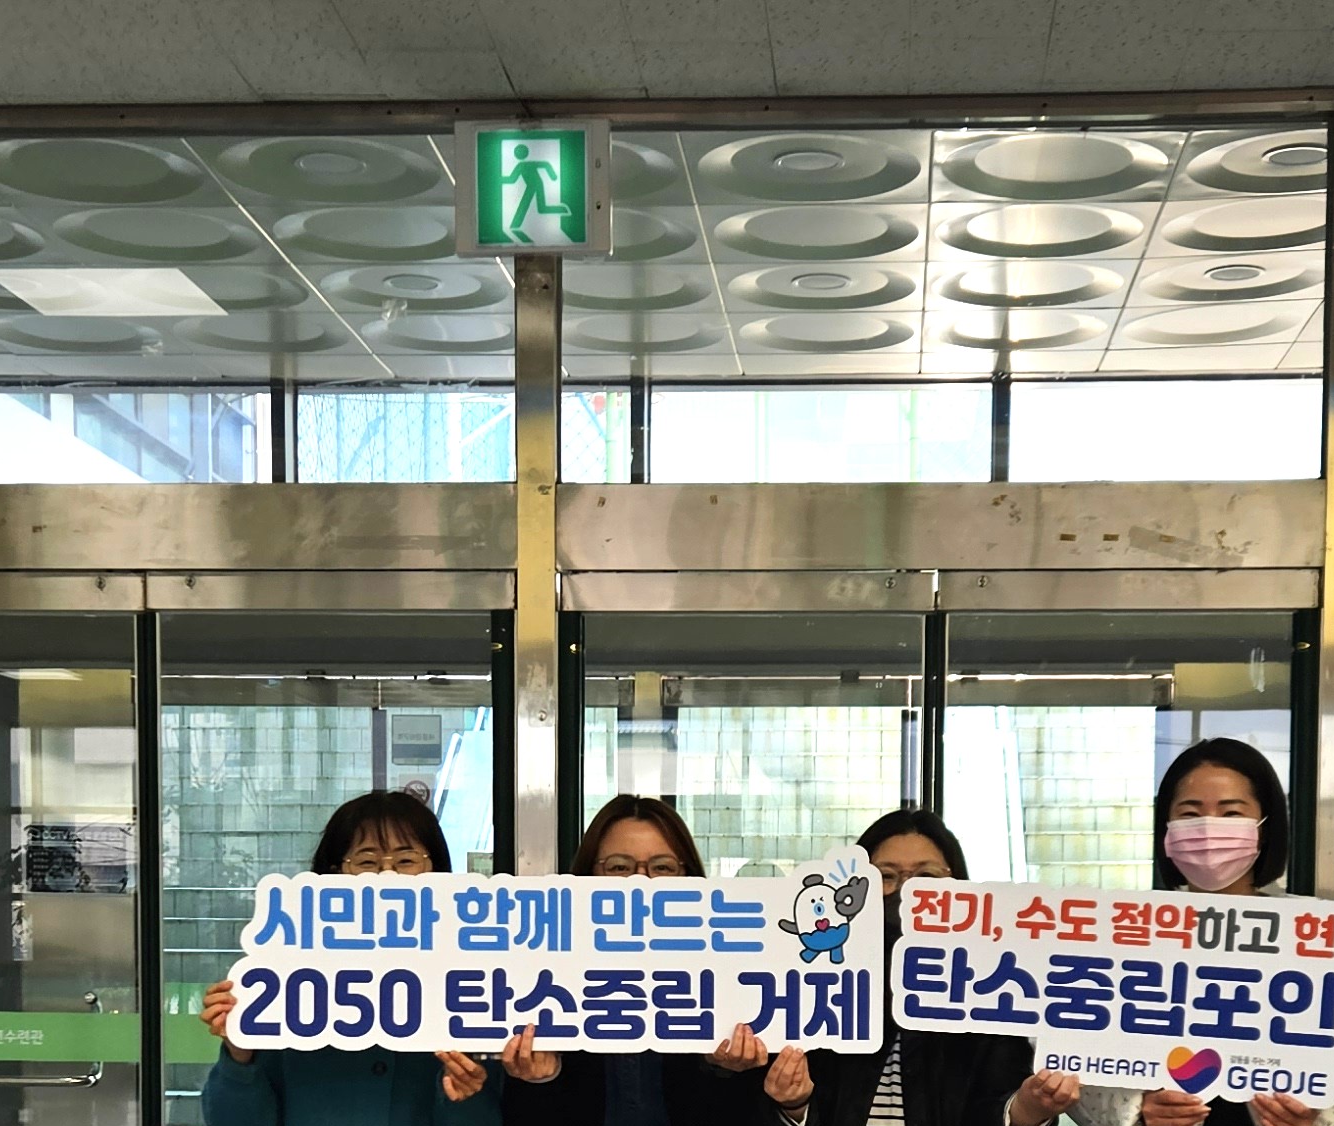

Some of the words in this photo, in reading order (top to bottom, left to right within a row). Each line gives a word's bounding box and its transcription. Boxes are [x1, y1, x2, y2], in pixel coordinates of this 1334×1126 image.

[254, 885, 440, 951] 시민과
[454, 885, 574, 952] 함께
[591, 886, 765, 953] 만드는
[910, 888, 1003, 942] 전기,
[1015, 895, 1099, 944] 수도
[1111, 902, 1281, 957] 절약하고
[239, 966, 422, 1039] 2050
[445, 967, 715, 1041] 탄소중립
[737, 967, 871, 1042] 거제
[1045, 1053, 1082, 1073] BIG
[1085, 1056, 1161, 1079] HEART
[1227, 1065, 1329, 1097] GEOJE
